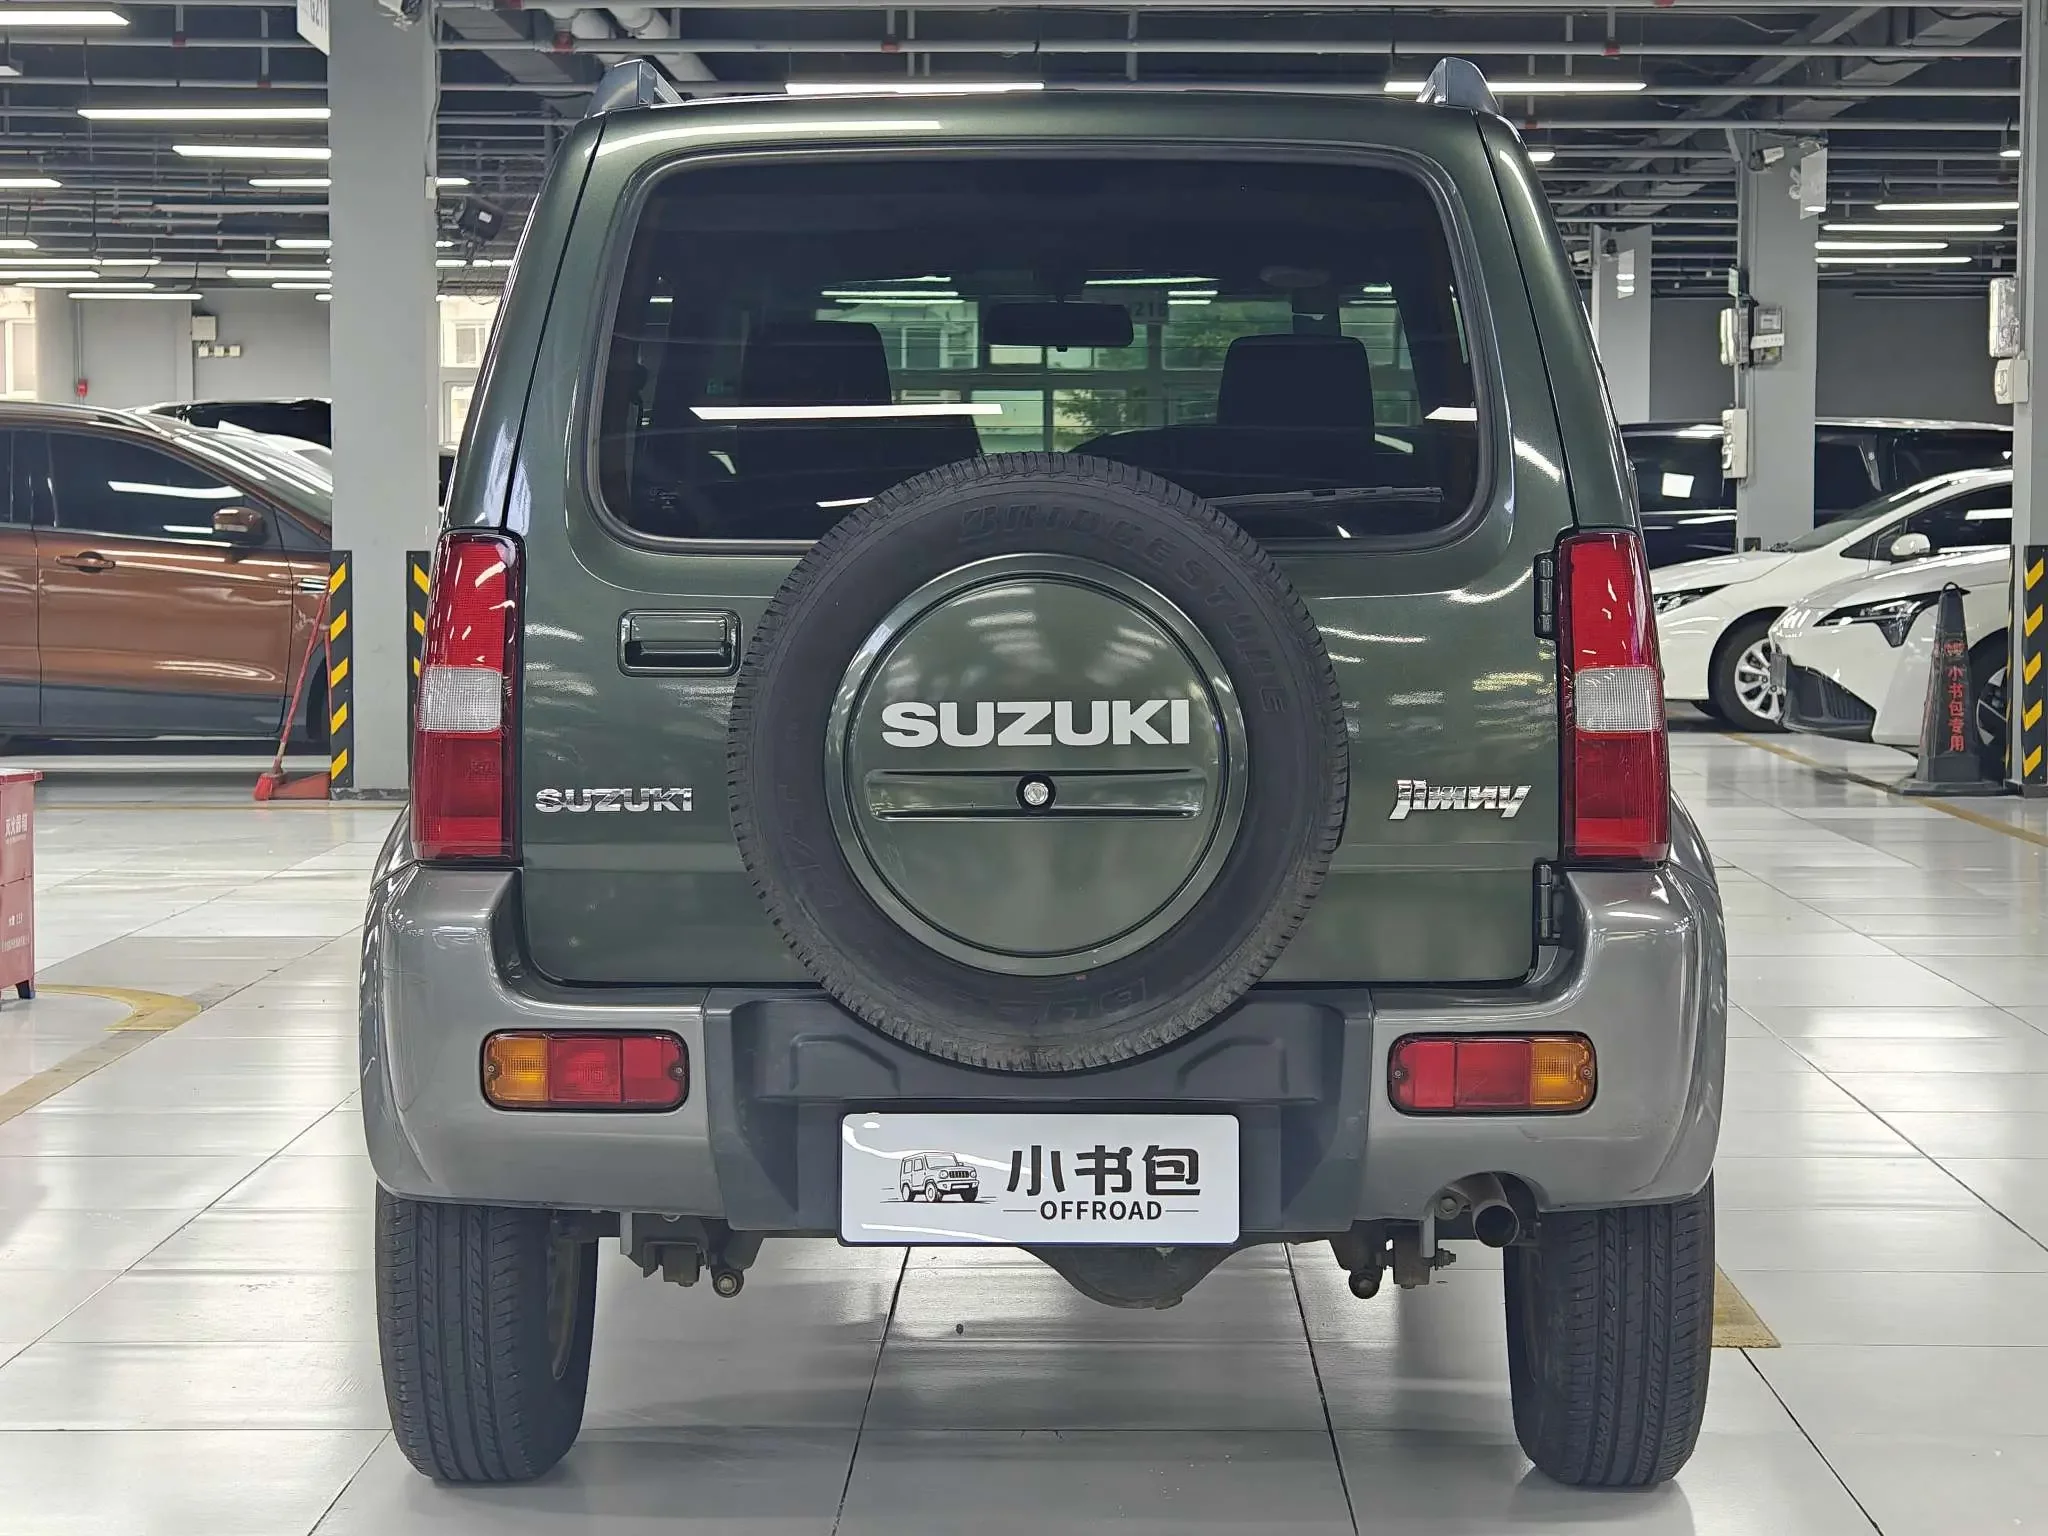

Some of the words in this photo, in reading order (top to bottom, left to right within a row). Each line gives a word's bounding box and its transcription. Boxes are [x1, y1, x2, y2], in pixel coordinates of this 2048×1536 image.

[881, 699, 1190, 748] SUZUKI
[535, 788, 692, 813] SUZUKI
[1006, 1145, 1201, 1197] 小书包
[1040, 1200, 1163, 1220] OFFROAD
